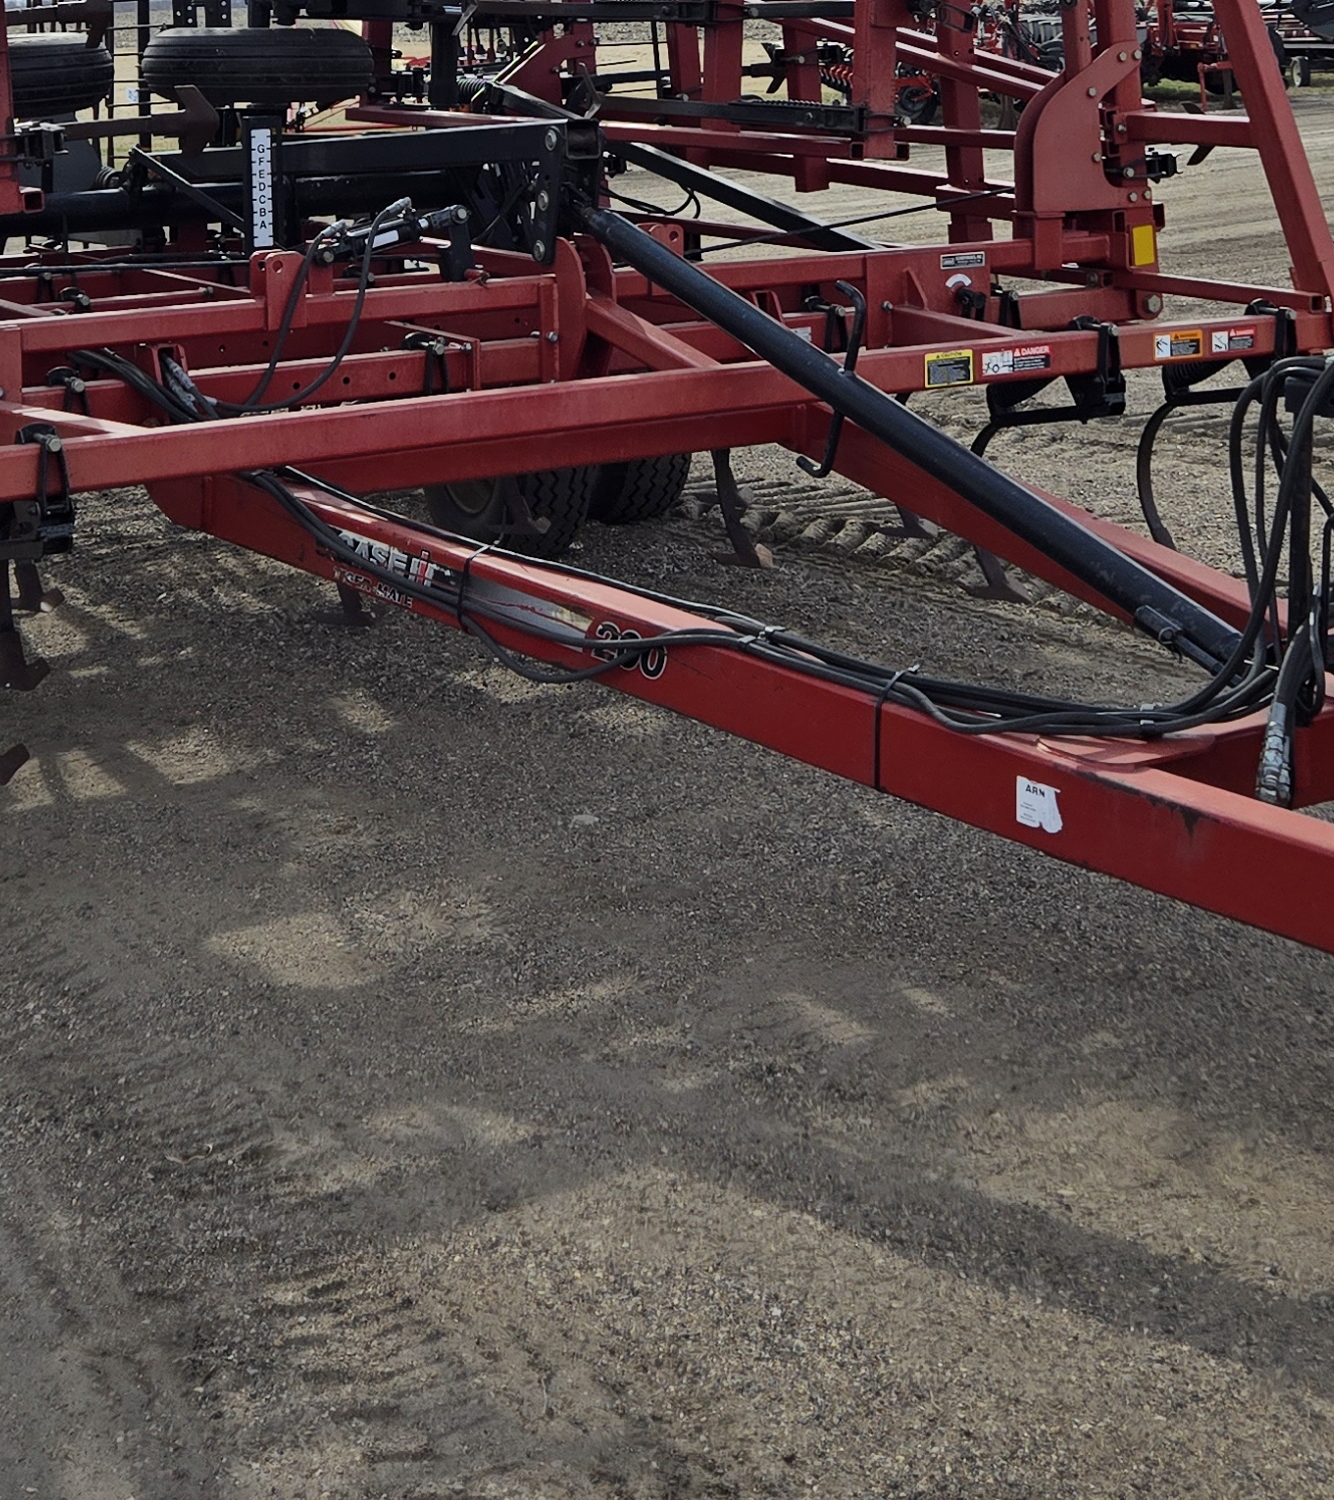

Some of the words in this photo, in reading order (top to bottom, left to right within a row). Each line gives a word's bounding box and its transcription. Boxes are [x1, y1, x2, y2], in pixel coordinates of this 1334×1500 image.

[257, 143, 265, 153] G
[258, 157, 265, 166] F
[258, 170, 265, 179] E
[258, 182, 266, 192] D
[258, 195, 266, 204] C
[259, 207, 267, 217] B
[259, 220, 267, 229] A
[1021, 345, 1050, 356] DANGER
